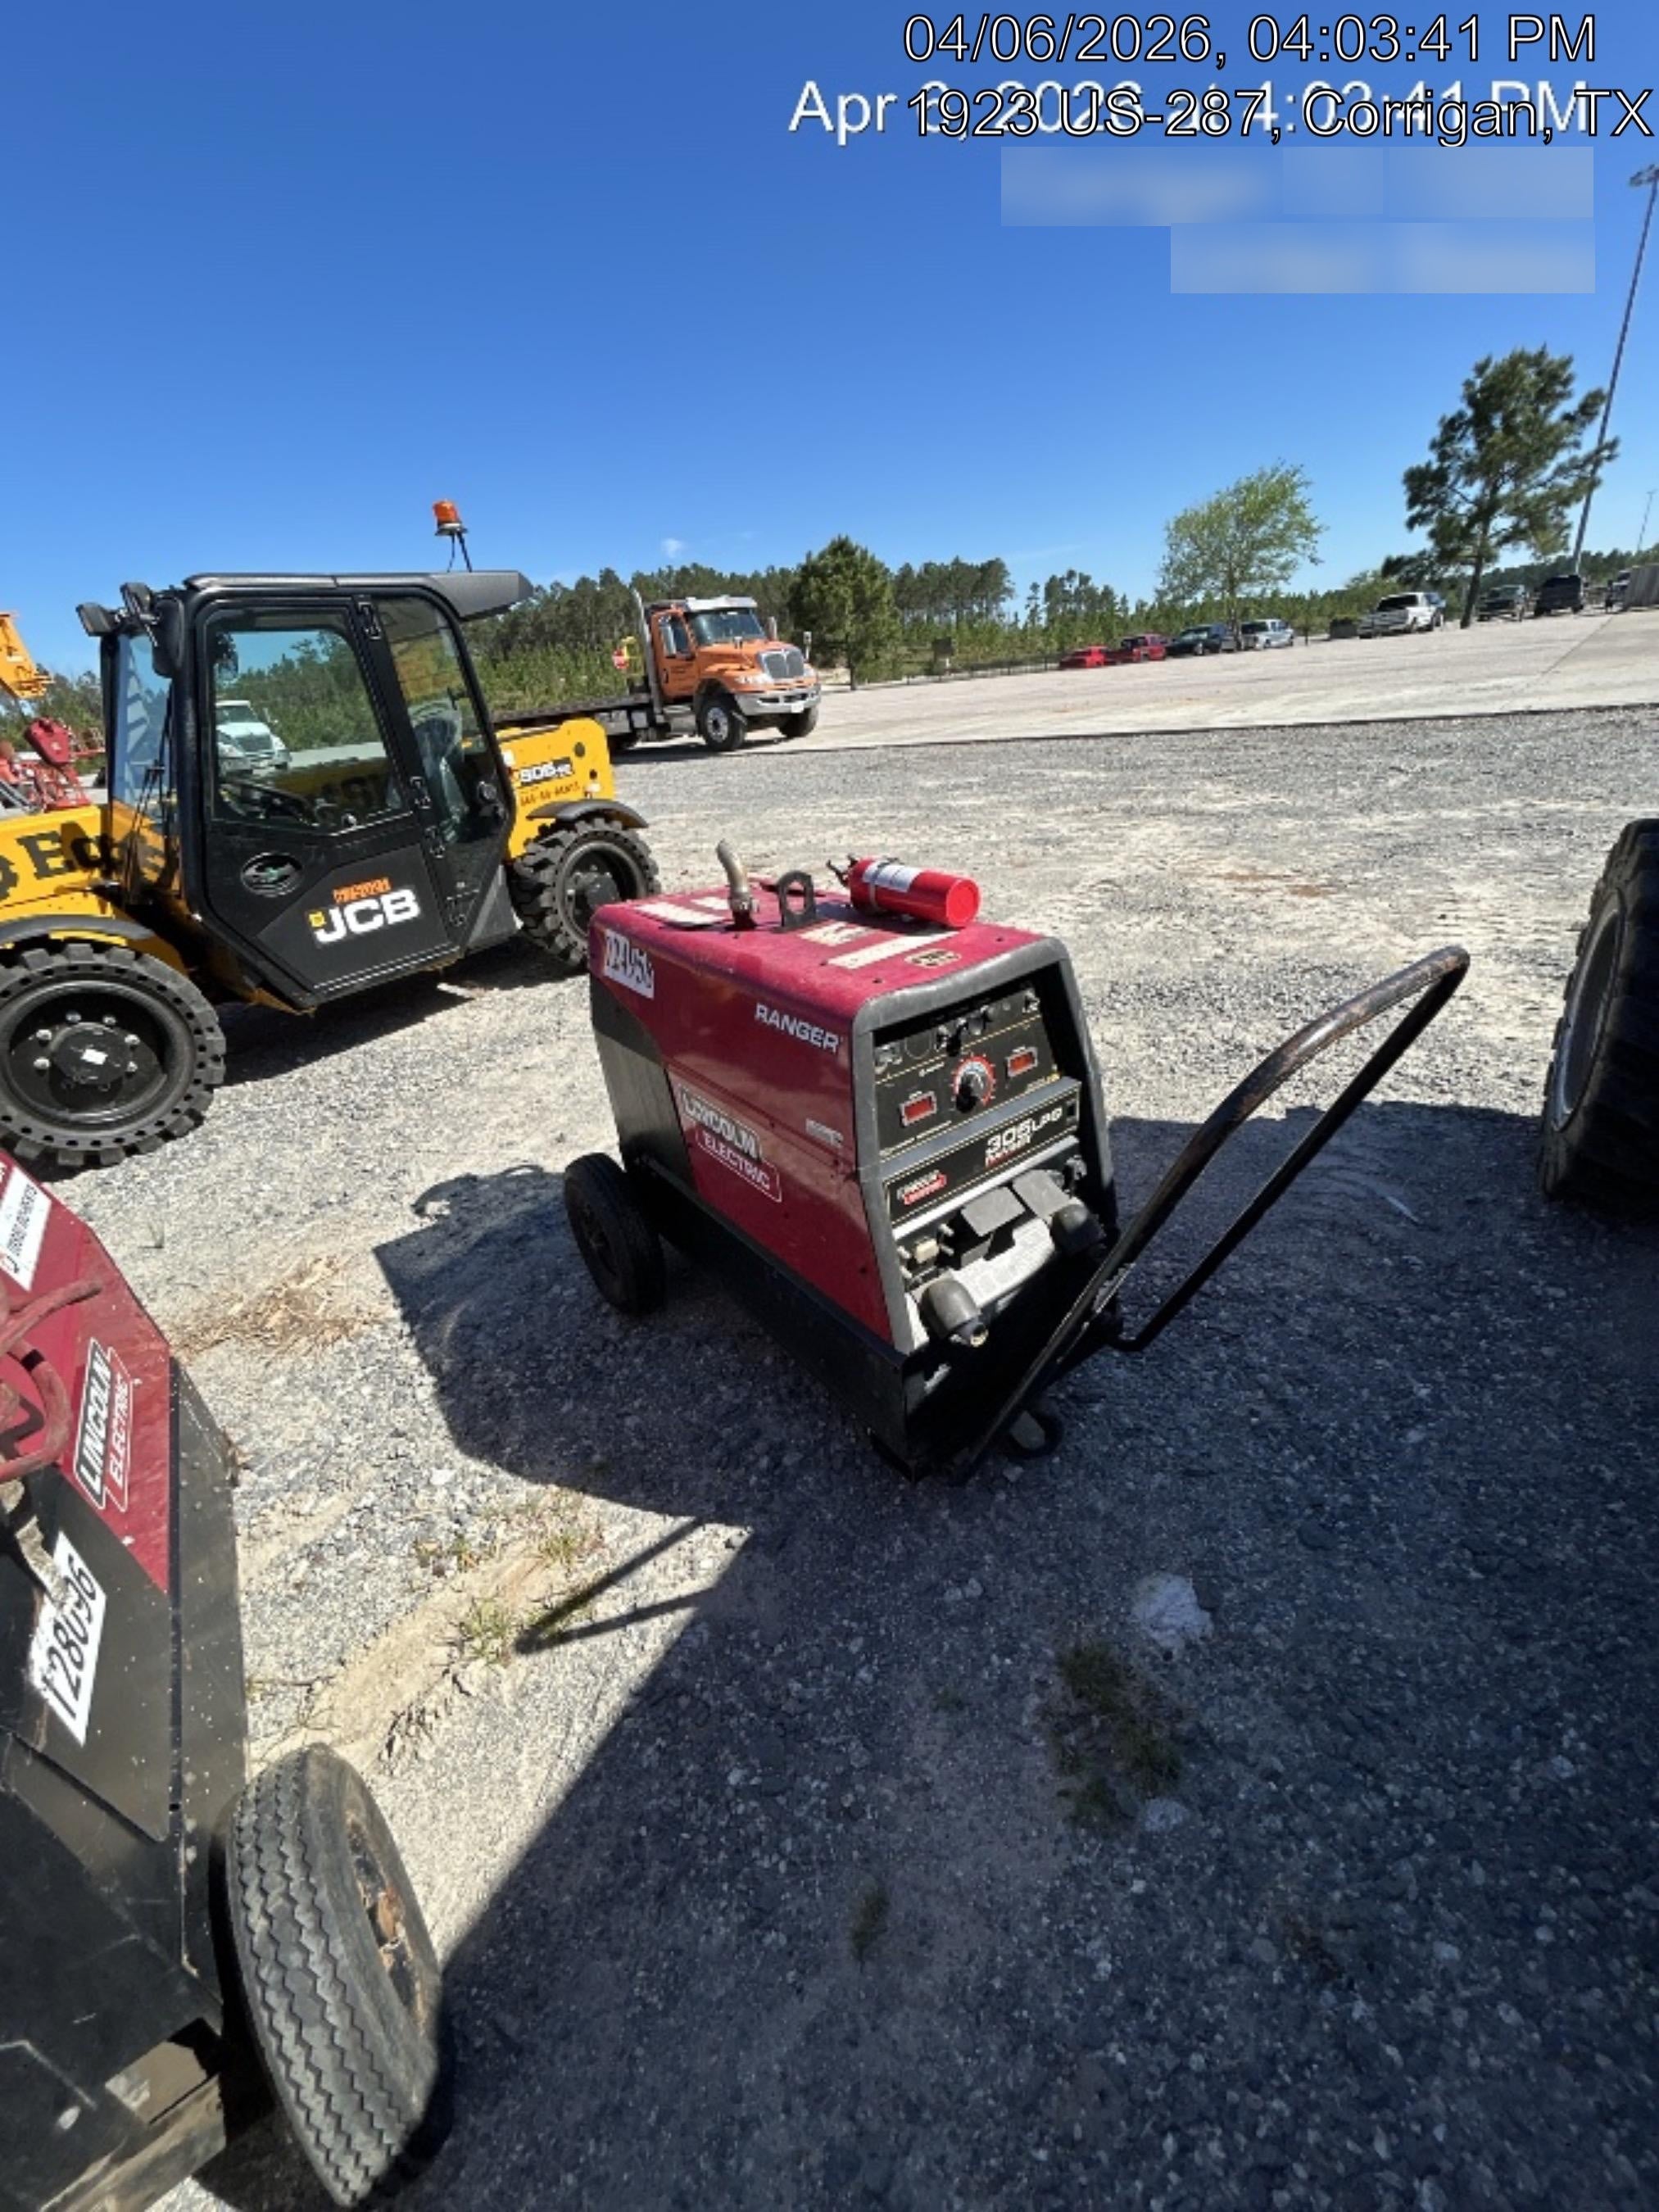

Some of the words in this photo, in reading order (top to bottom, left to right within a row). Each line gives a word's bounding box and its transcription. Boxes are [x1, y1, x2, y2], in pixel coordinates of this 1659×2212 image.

[314, 888, 420, 943] JCB
[755, 1001, 840, 1054] RANGER
[681, 1088, 760, 1159] LINCOLN
[702, 1129, 771, 1190] ELECTRIC
[79, 1350, 112, 1496] LINCOLN
[108, 1371, 129, 1490] ELECTRIC
